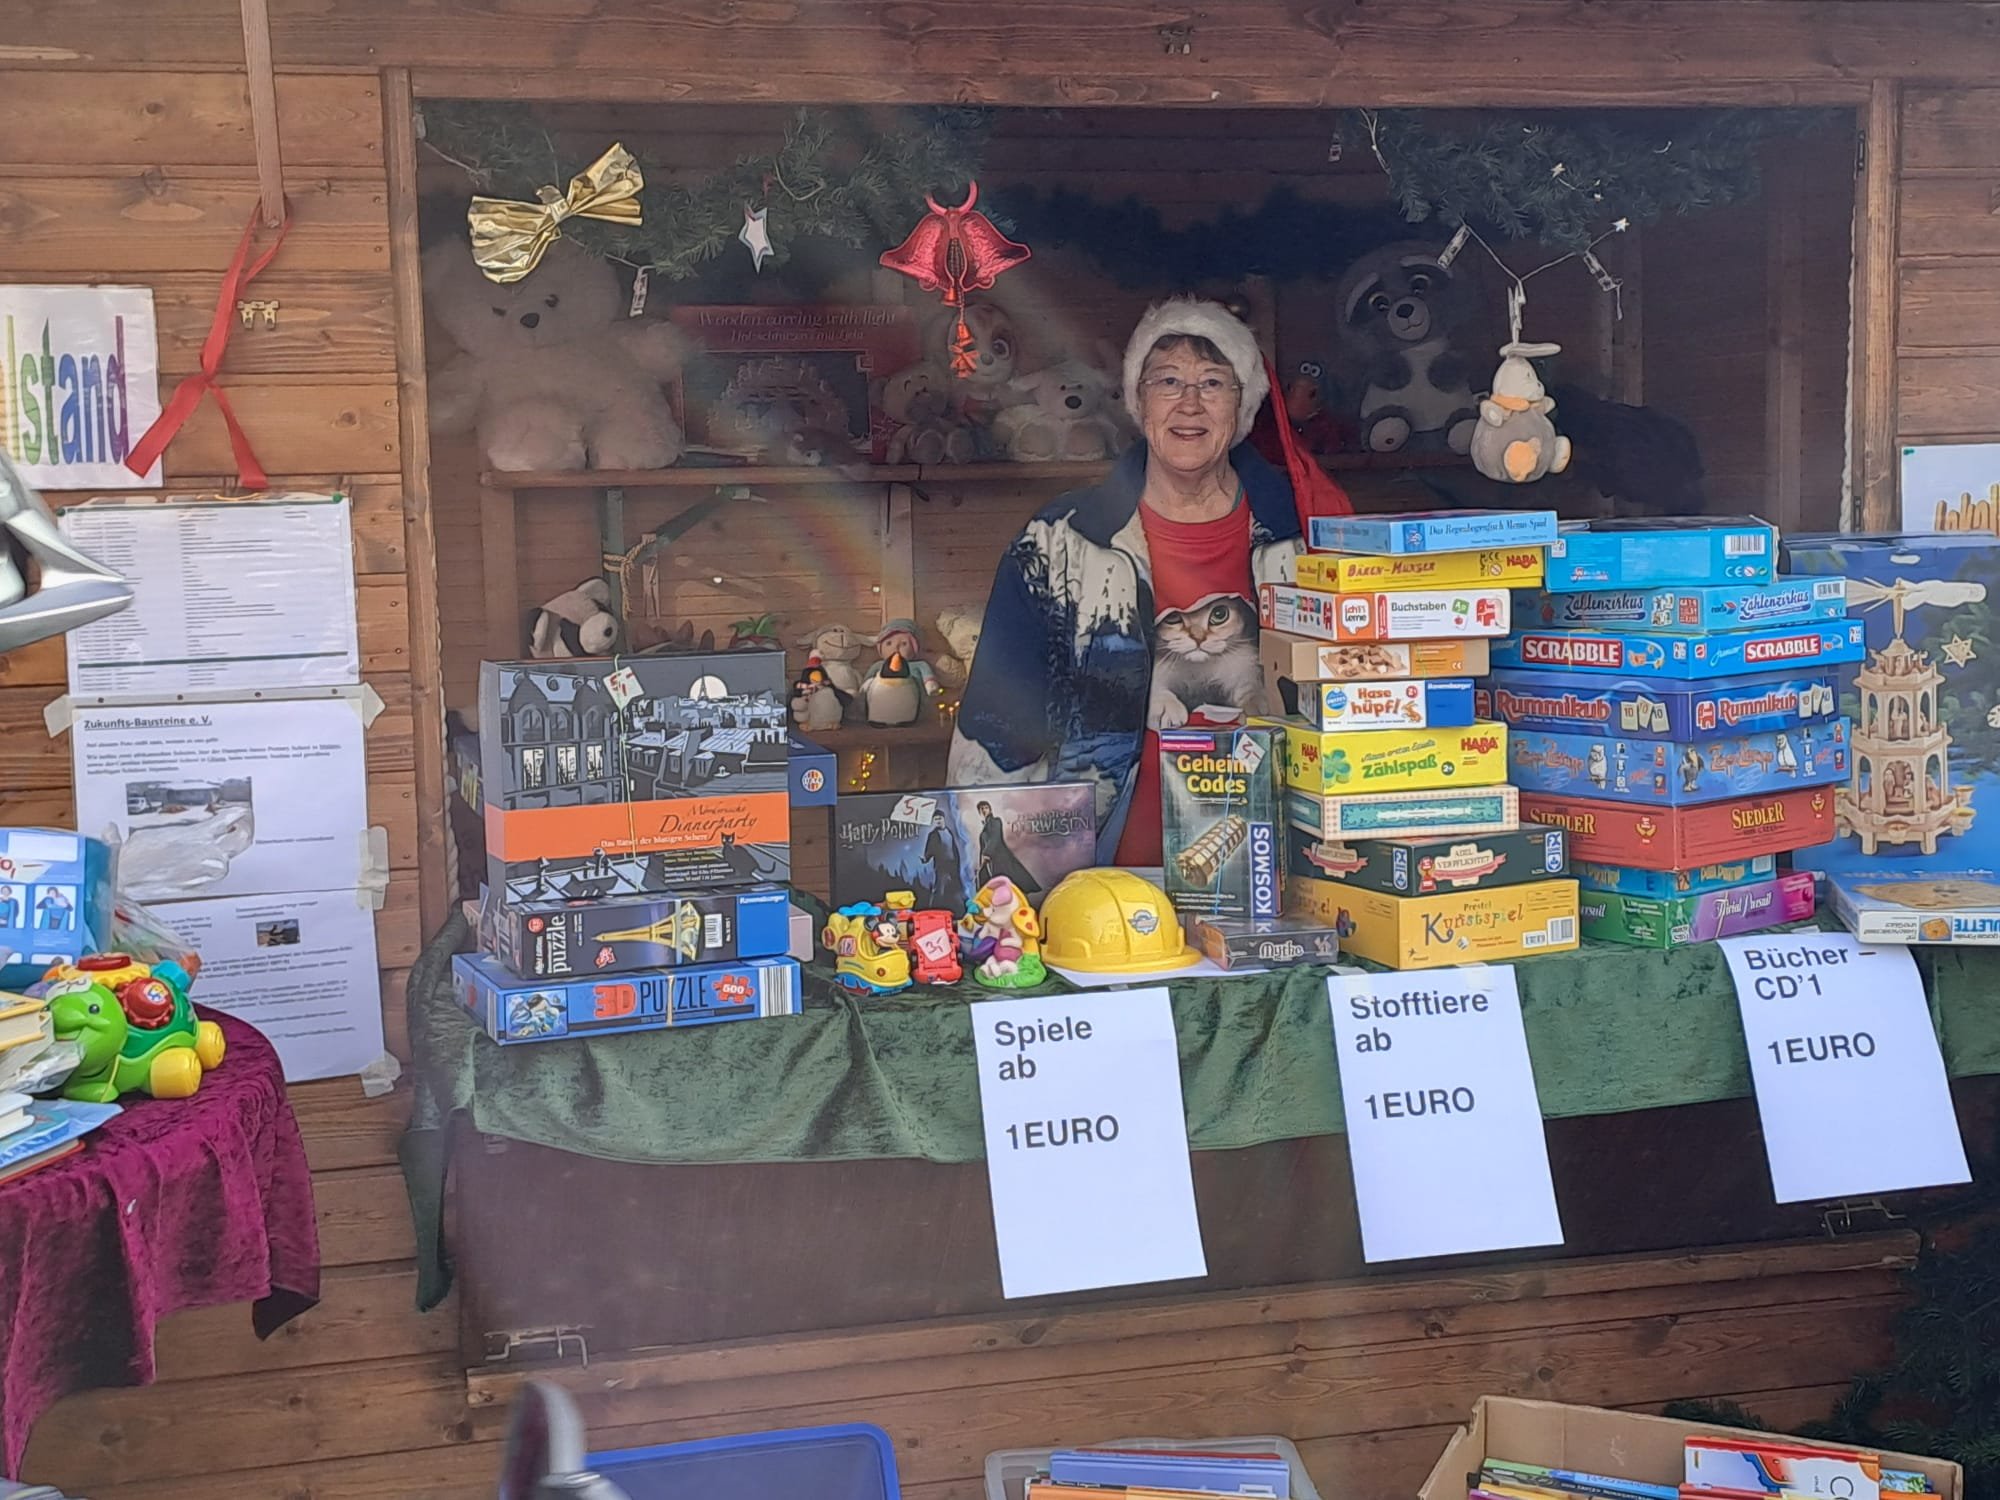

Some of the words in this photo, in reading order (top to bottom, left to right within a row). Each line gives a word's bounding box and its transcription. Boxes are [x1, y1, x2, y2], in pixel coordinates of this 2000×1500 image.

[0, 315, 130, 465] lstand
[1506, 554, 1538, 568] HABA
[1391, 602, 1447, 612] Buchstaben
[1525, 640, 1620, 663] SCRABBLE
[1747, 637, 1819, 660] SCRABBLE
[1357, 687, 1392, 699] Hase
[1495, 690, 1611, 721] Rummikub
[1351, 699, 1400, 717] hüpf!
[1719, 691, 1798, 726] Rummikub
[84, 717, 186, 729] Zukunfts-Bausteine
[201, 715, 212, 726] V.
[1461, 737, 1499, 754] HABA
[1361, 753, 1438, 778] Zählspaß
[1186, 775, 1247, 793] Codes
[1731, 801, 1785, 830] SIEDLER
[1255, 827, 1272, 914] KOSMOS
[1420, 903, 1525, 946] Kunstspiel
[1954, 918, 2000, 932] ULETTE
[552, 913, 572, 974] puzzle
[1744, 946, 1849, 970] Bücher
[594, 984, 636, 1018] 3D
[1351, 990, 1489, 1021] Stofftiere
[994, 1016, 1093, 1051] Spiele
[1355, 1026, 1393, 1053] ab
[1767, 1031, 1876, 1065] 1EURO
[998, 1053, 1037, 1081] ab
[1363, 1086, 1476, 1121] 1EURO
[1005, 1114, 1120, 1151] 1EURO
[1830, 1476, 1854, 1500] C
